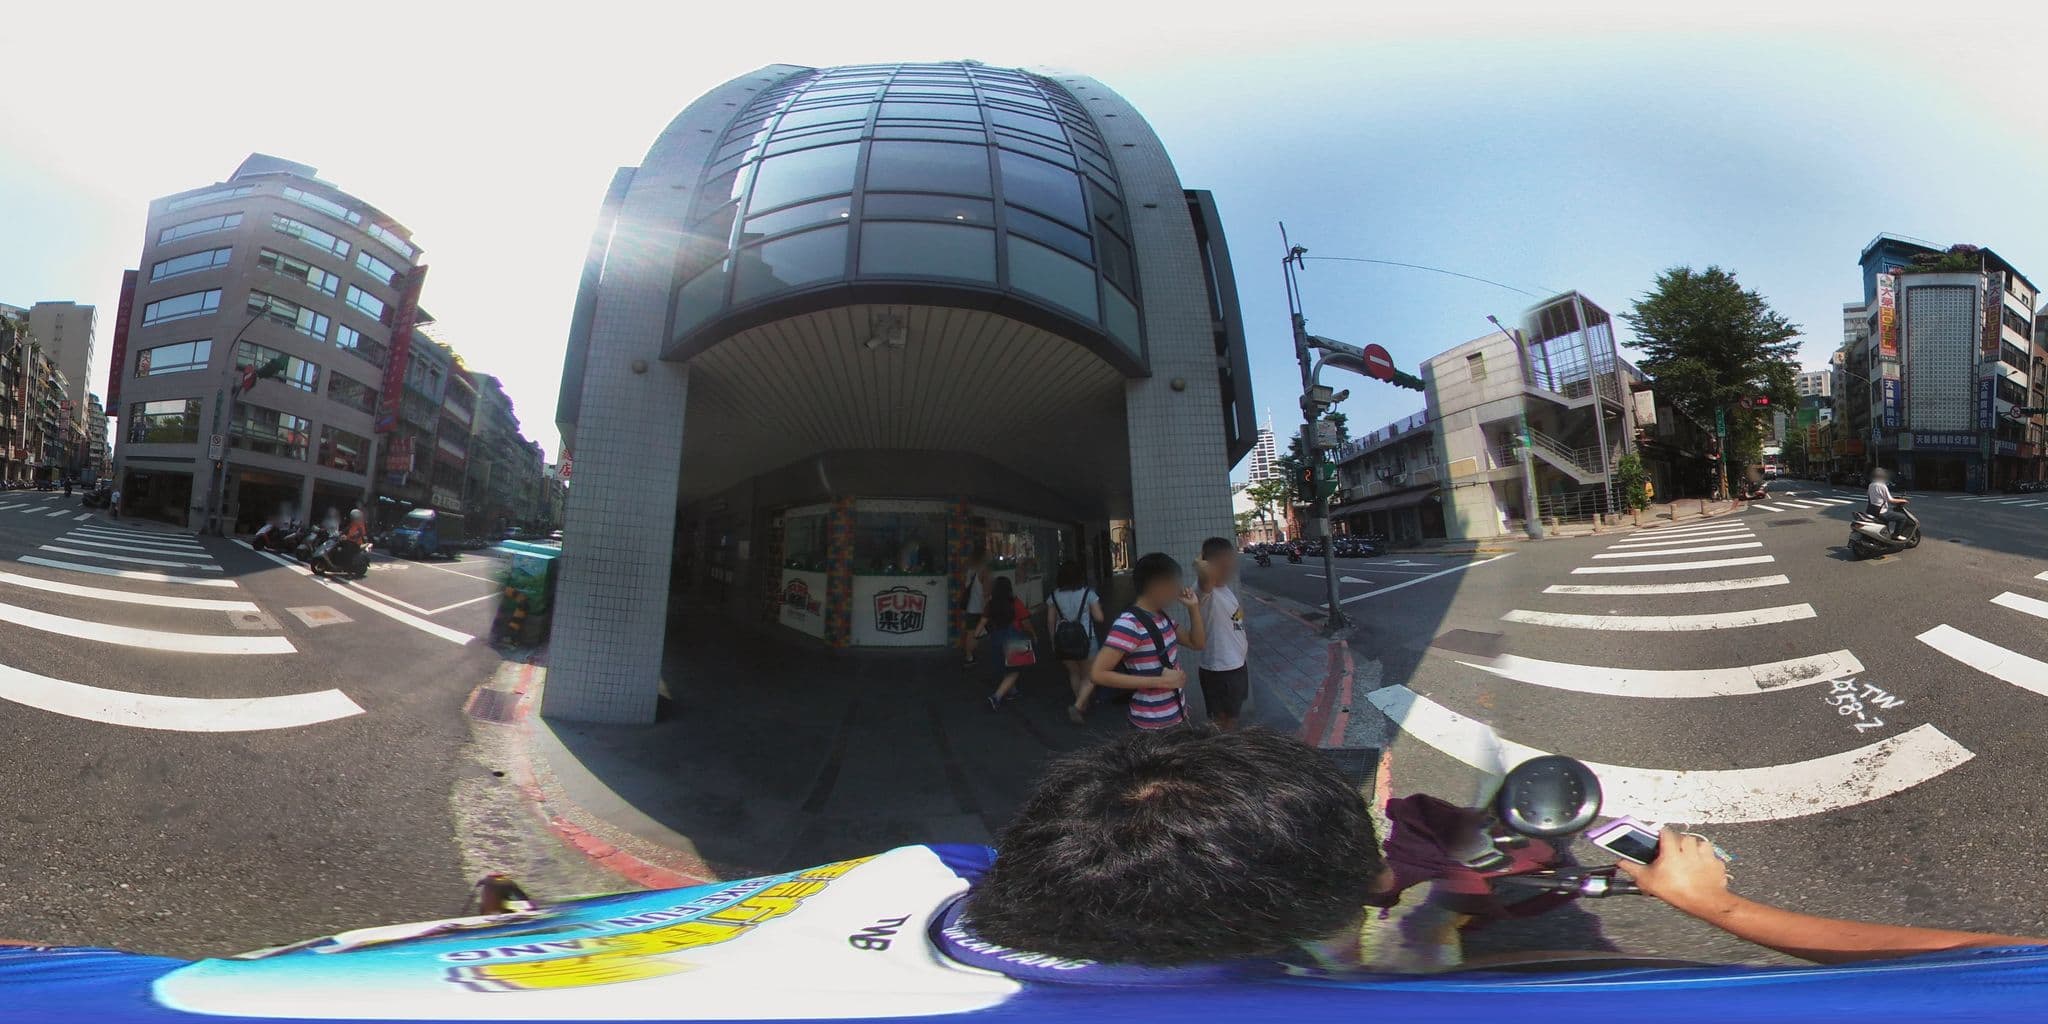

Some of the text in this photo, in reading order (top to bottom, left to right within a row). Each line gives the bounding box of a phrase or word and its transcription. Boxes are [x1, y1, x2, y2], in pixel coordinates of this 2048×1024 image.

[878, 595, 923, 611] FUN
[1860, 684, 1905, 708] TW
[694, 879, 770, 905] BIKE
[606, 905, 706, 928] FUN
